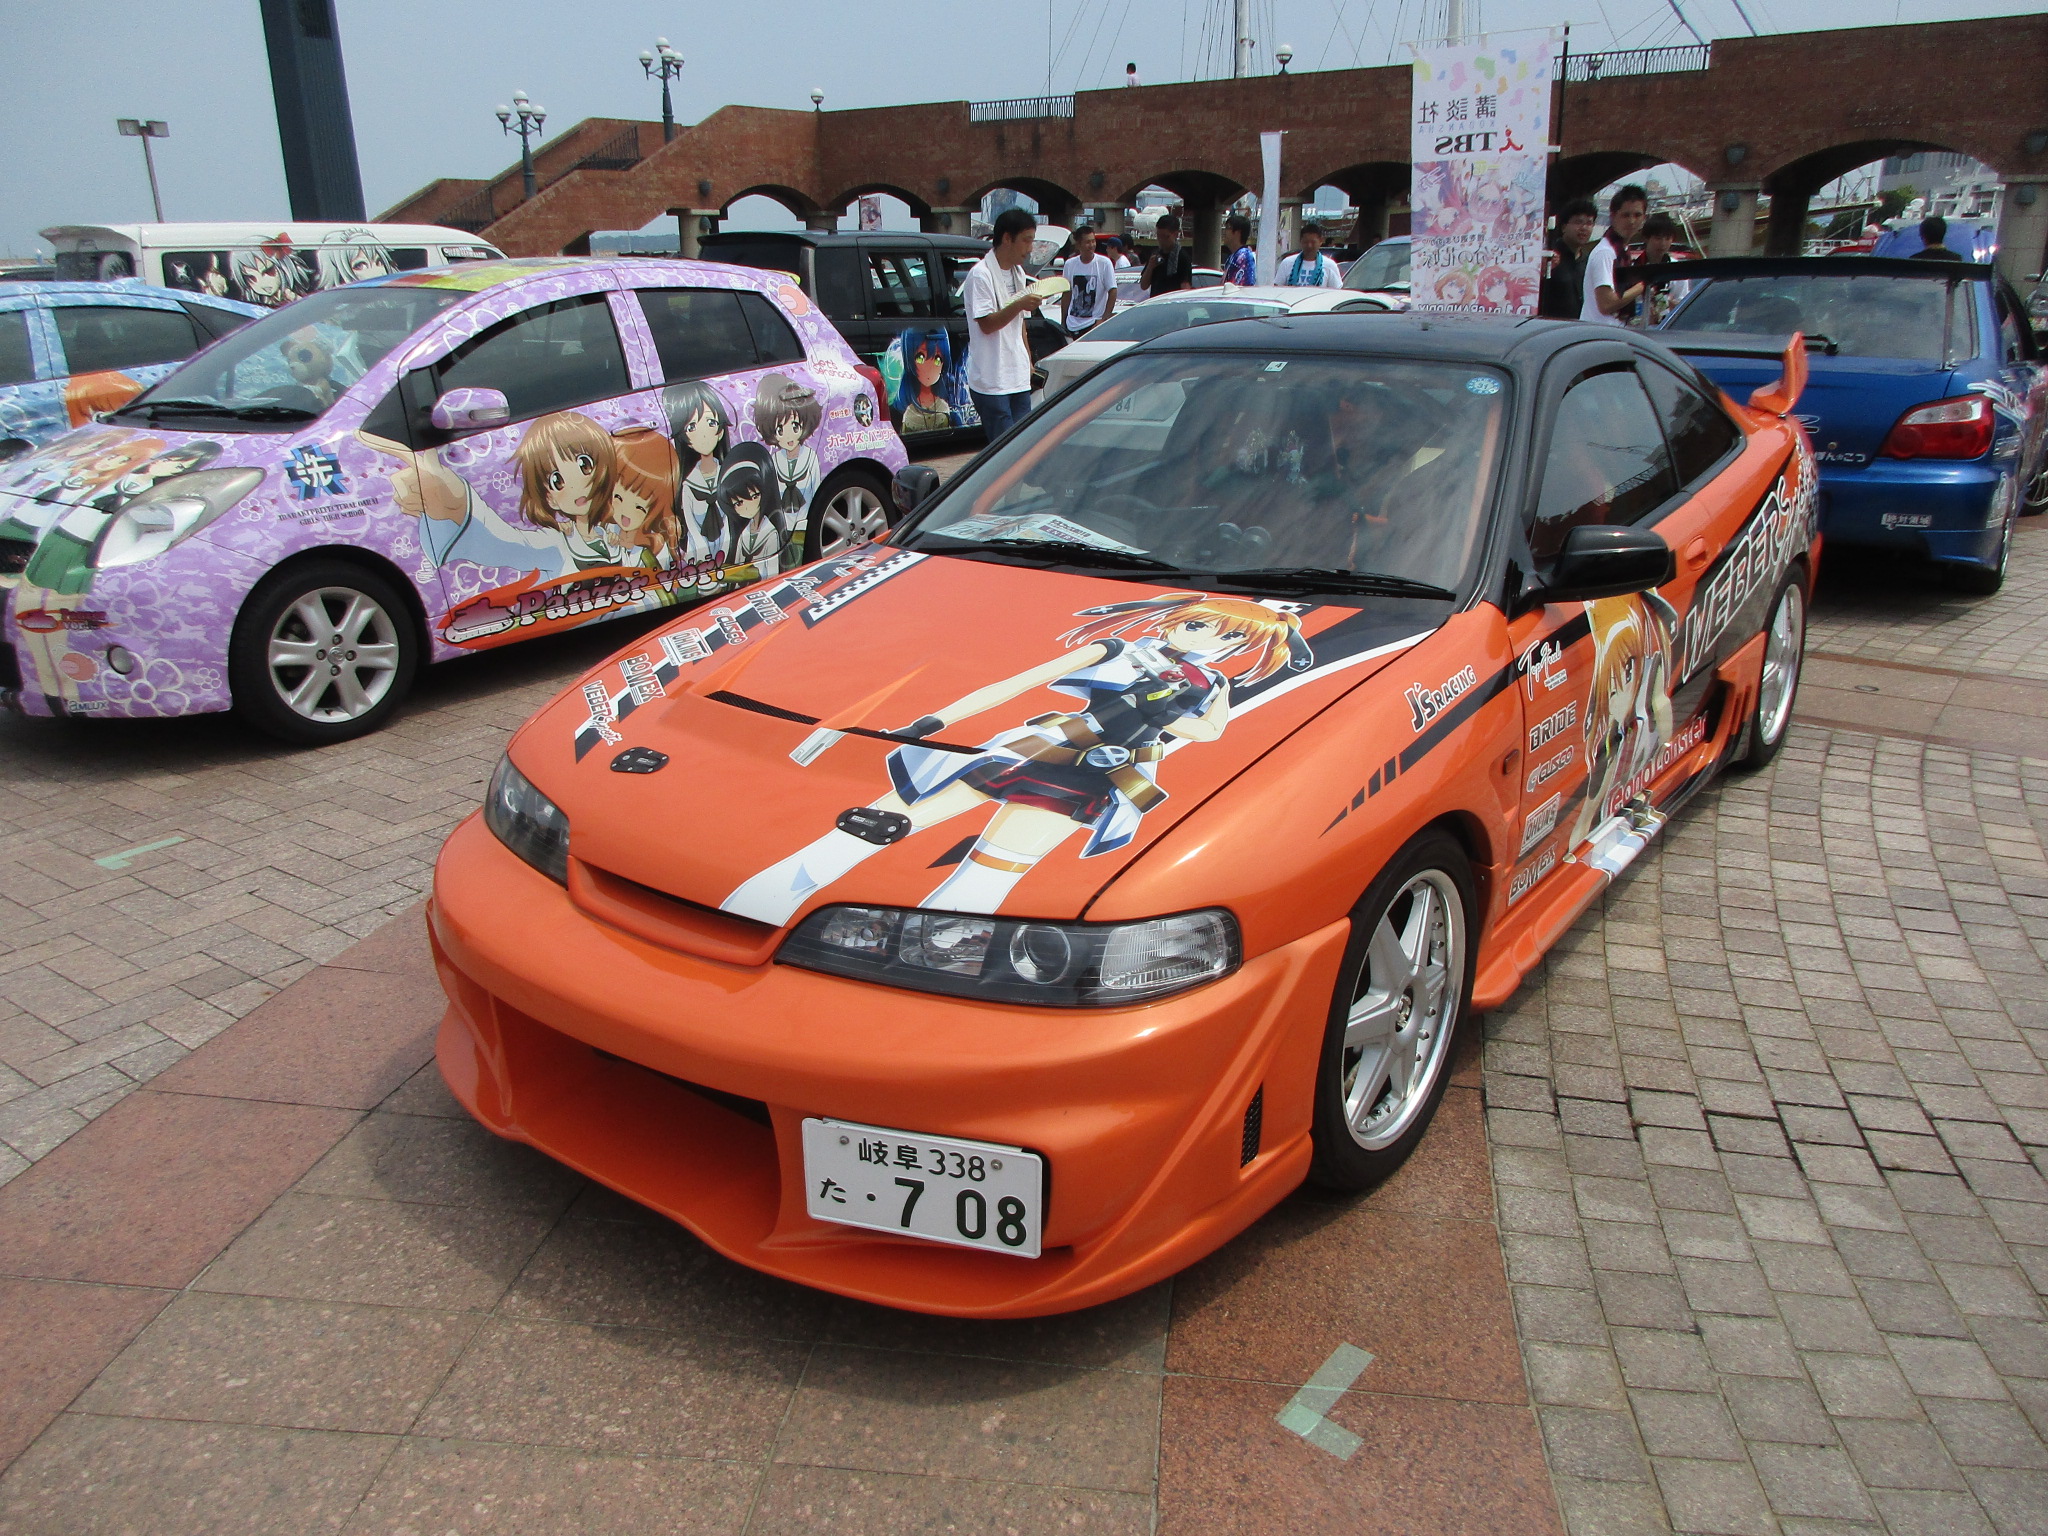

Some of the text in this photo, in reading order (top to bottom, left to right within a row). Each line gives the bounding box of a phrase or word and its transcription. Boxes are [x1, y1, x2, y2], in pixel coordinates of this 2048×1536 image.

[744, 590, 790, 625] BRIDE
[1529, 700, 1576, 753] BRIDE
[858, 1137, 987, 1182] 岐阜 338
